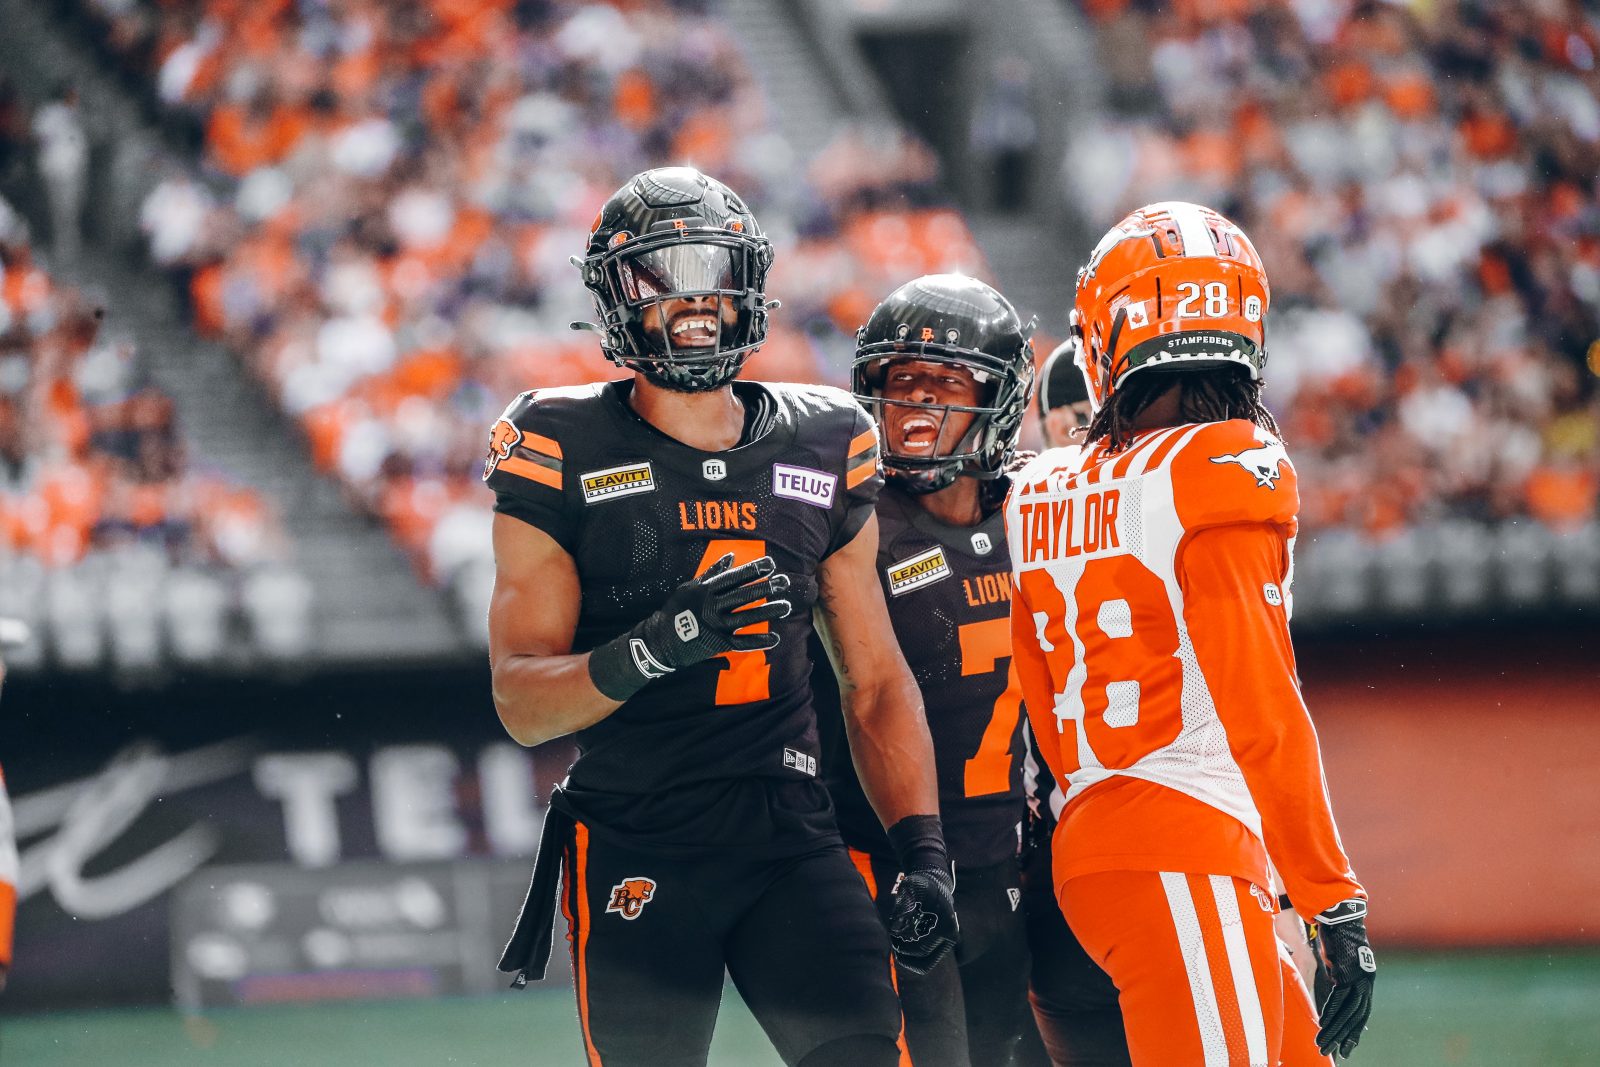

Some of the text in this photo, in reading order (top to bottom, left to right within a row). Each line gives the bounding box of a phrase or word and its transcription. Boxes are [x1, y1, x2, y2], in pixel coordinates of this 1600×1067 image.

[1176, 282, 1229, 318] 28
[1168, 336, 1234, 348] STAMPEDERS
[586, 470, 647, 489] LEAVITT
[706, 465, 723, 475] CFL
[778, 472, 831, 498] TELUS
[679, 501, 756, 531] LIONS
[1019, 489, 1120, 563] TAYLOR
[893, 555, 941, 582] LEAVITT
[962, 571, 1014, 607] LION
[679, 615, 692, 637] CFL
[1020, 553, 1184, 776] 28
[958, 616, 1024, 799] 7
